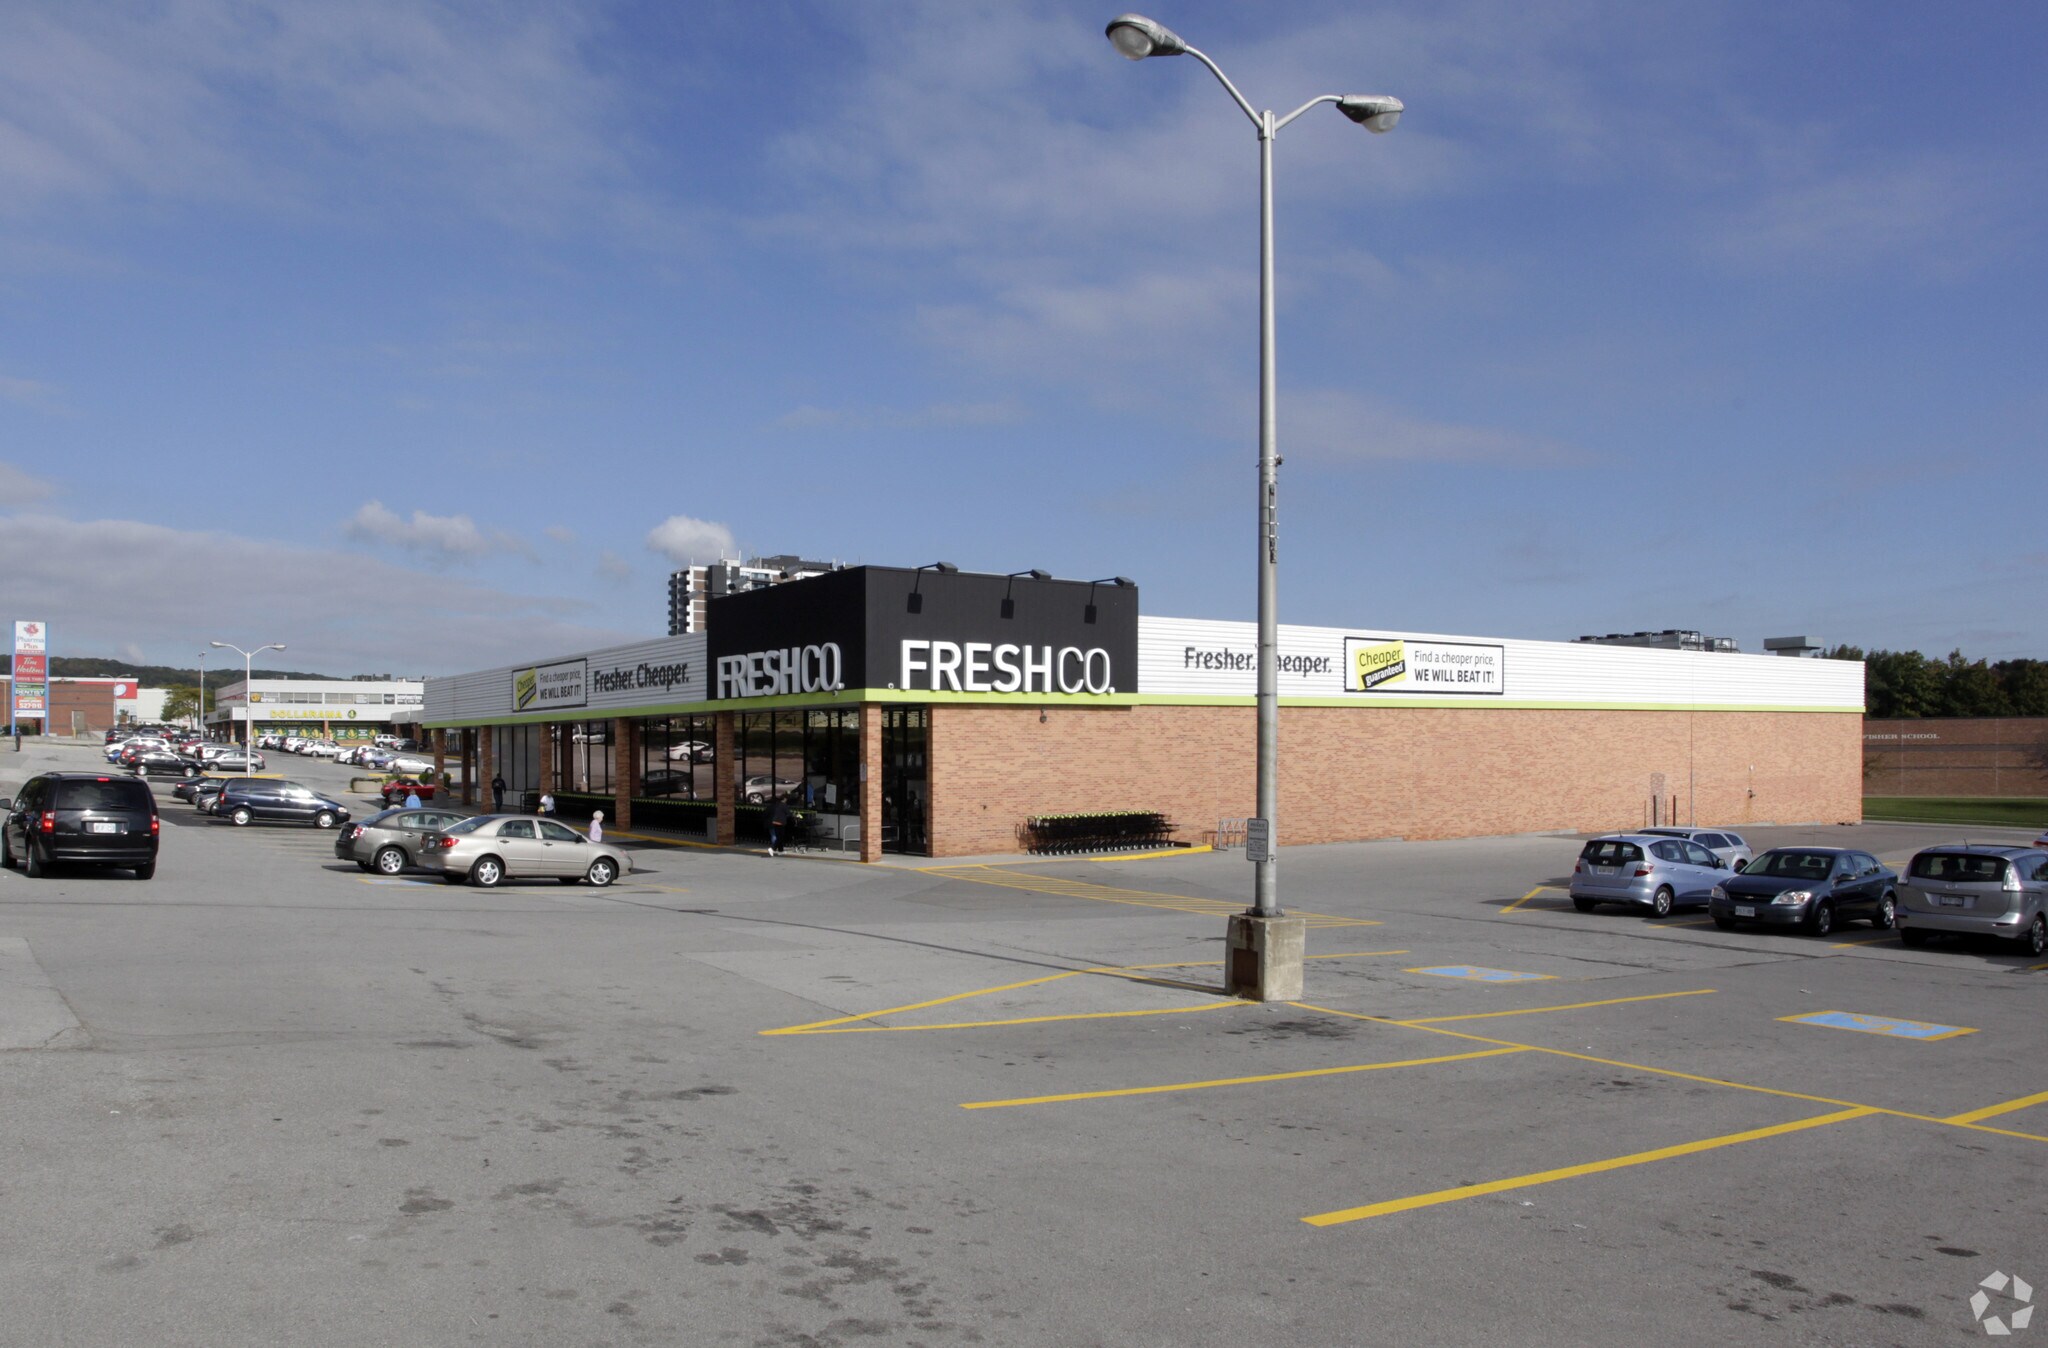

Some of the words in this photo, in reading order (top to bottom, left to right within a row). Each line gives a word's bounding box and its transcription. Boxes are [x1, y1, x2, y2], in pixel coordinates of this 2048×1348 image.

[24, 657, 38, 666] Tim
[1185, 647, 1256, 670] Fresher.
[1277, 655, 1332, 678] eaper.
[1359, 649, 1401, 667] Cheaper
[1414, 650, 1433, 663] Find
[1435, 653, 1440, 663] a
[1442, 652, 1473, 667] cheaper
[1474, 654, 1495, 666] price,
[16, 665, 44, 674] Hortons
[540, 672, 549, 684] Find
[553, 671, 569, 684] cheaper
[594, 667, 634, 692] Fresher.
[637, 662, 690, 692] Cheaper.
[1365, 661, 1404, 686] guaranteed
[1414, 668, 1430, 682] WE
[1432, 669, 1455, 683] WILL
[1457, 670, 1481, 683] BEAT
[1483, 670, 1495, 684] IT!
[540, 688, 548, 700] WE
[548, 686, 560, 699] WILL
[560, 685, 573, 698] BEAT
[270, 710, 343, 719] DOLLARAMA
